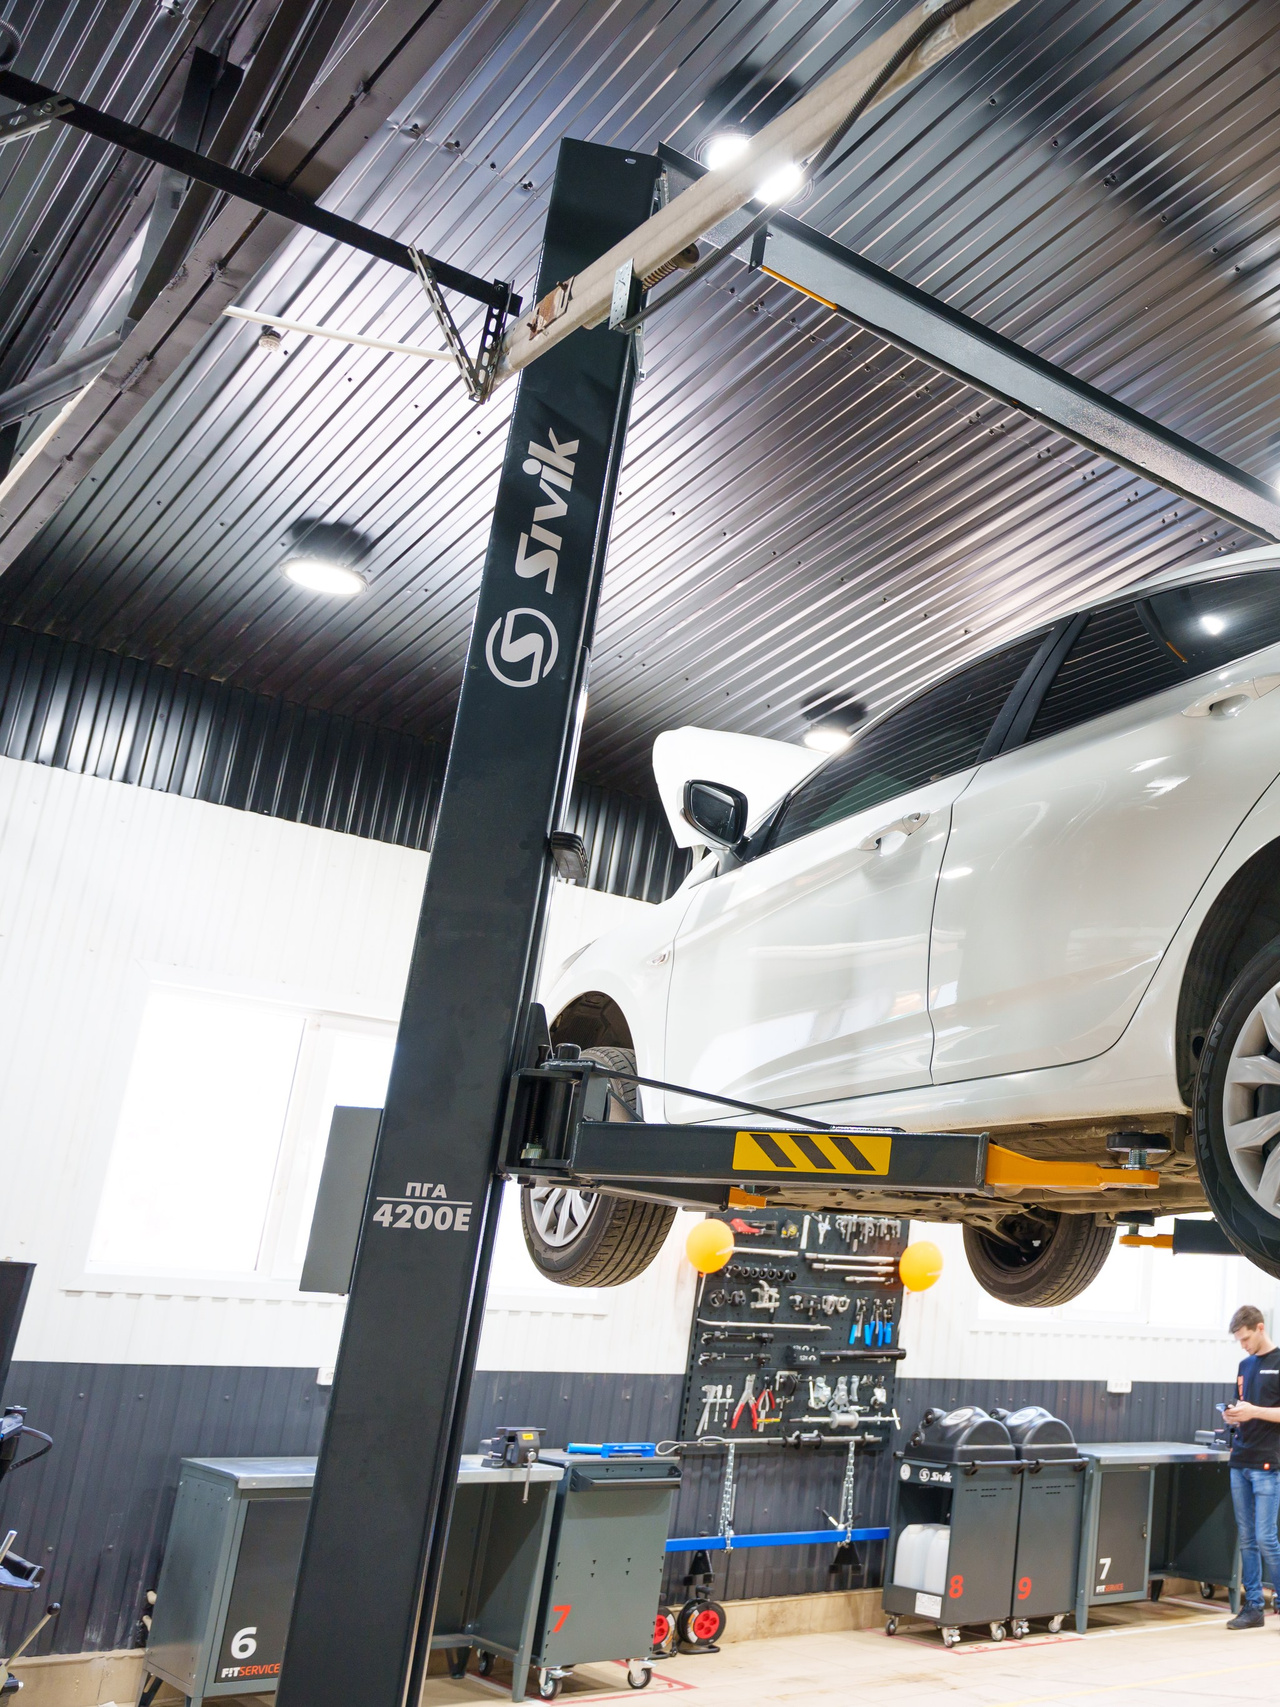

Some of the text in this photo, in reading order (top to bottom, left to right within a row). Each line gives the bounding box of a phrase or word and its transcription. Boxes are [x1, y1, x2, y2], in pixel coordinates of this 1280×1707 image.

[1197, 1021, 1225, 1161] NEXEN
[405, 1182, 448, 1198] ПГА
[372, 1203, 472, 1231] 4200E
[1098, 1557, 1112, 1580] 7
[948, 1574, 964, 1599] 8
[1017, 1576, 1032, 1600] 9
[552, 1604, 572, 1633] 7
[231, 1626, 257, 1660] 6
